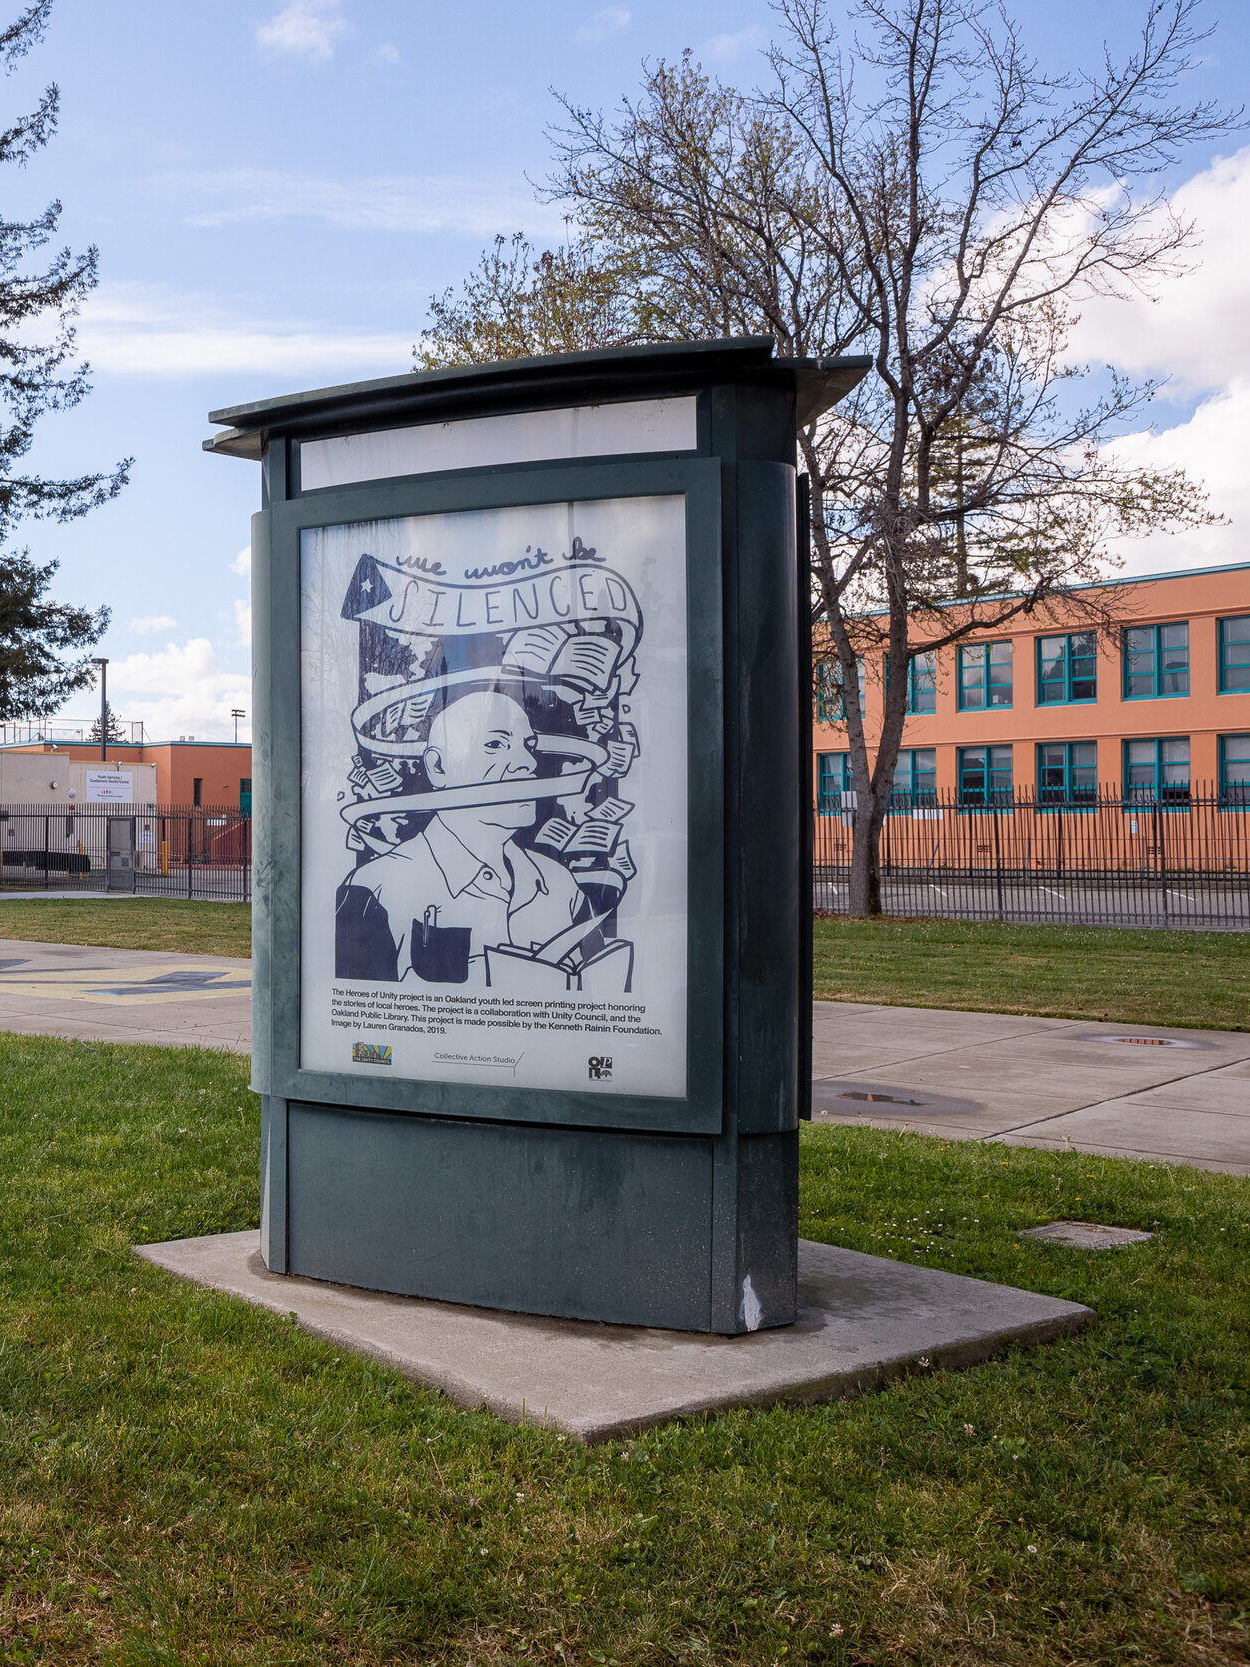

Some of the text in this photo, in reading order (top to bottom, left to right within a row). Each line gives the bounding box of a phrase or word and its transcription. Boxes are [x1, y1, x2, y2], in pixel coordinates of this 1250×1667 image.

[396, 536, 606, 579] we won't be
[388, 573, 627, 628] SILENCED
[331, 987, 344, 996] The
[345, 988, 370, 997] Heroes
[370, 989, 378, 998] of
[379, 989, 398, 1001] Unity
[398, 990, 424, 1002] project
[425, 992, 432, 1001] is
[444, 993, 476, 1003] Oakland
[477, 995, 500, 1006] youth
[502, 996, 514, 1005] led
[544, 998, 576, 1010] printing
[577, 1000, 606, 1012] project
[607, 1001, 646, 1014] honoring
[331, 997, 342, 1006] the
[342, 998, 366, 1007] stories
[366, 999, 375, 1008] of
[375, 999, 392, 1009] local
[393, 1000, 420, 1010] heroes.
[421, 1002, 436, 1011] The
[437, 1003, 464, 1015] project
[465, 1004, 472, 1013] is
[478, 1005, 531, 1017] collaboration
[532, 1008, 550, 1018] with
[551, 1009, 573, 1021] Unity
[574, 1010, 608, 1022] Council,
[609, 1012, 626, 1022] and
[626, 1013, 641, 1023] the
[331, 1007, 662, 1035] Oakland Public Library. This project is made possible by the Kenneth Rainin Foundation.
[331, 1017, 446, 1034] Image by Lauren Granados, 2019.
[434, 1052, 516, 1064] Collective Action Studio
